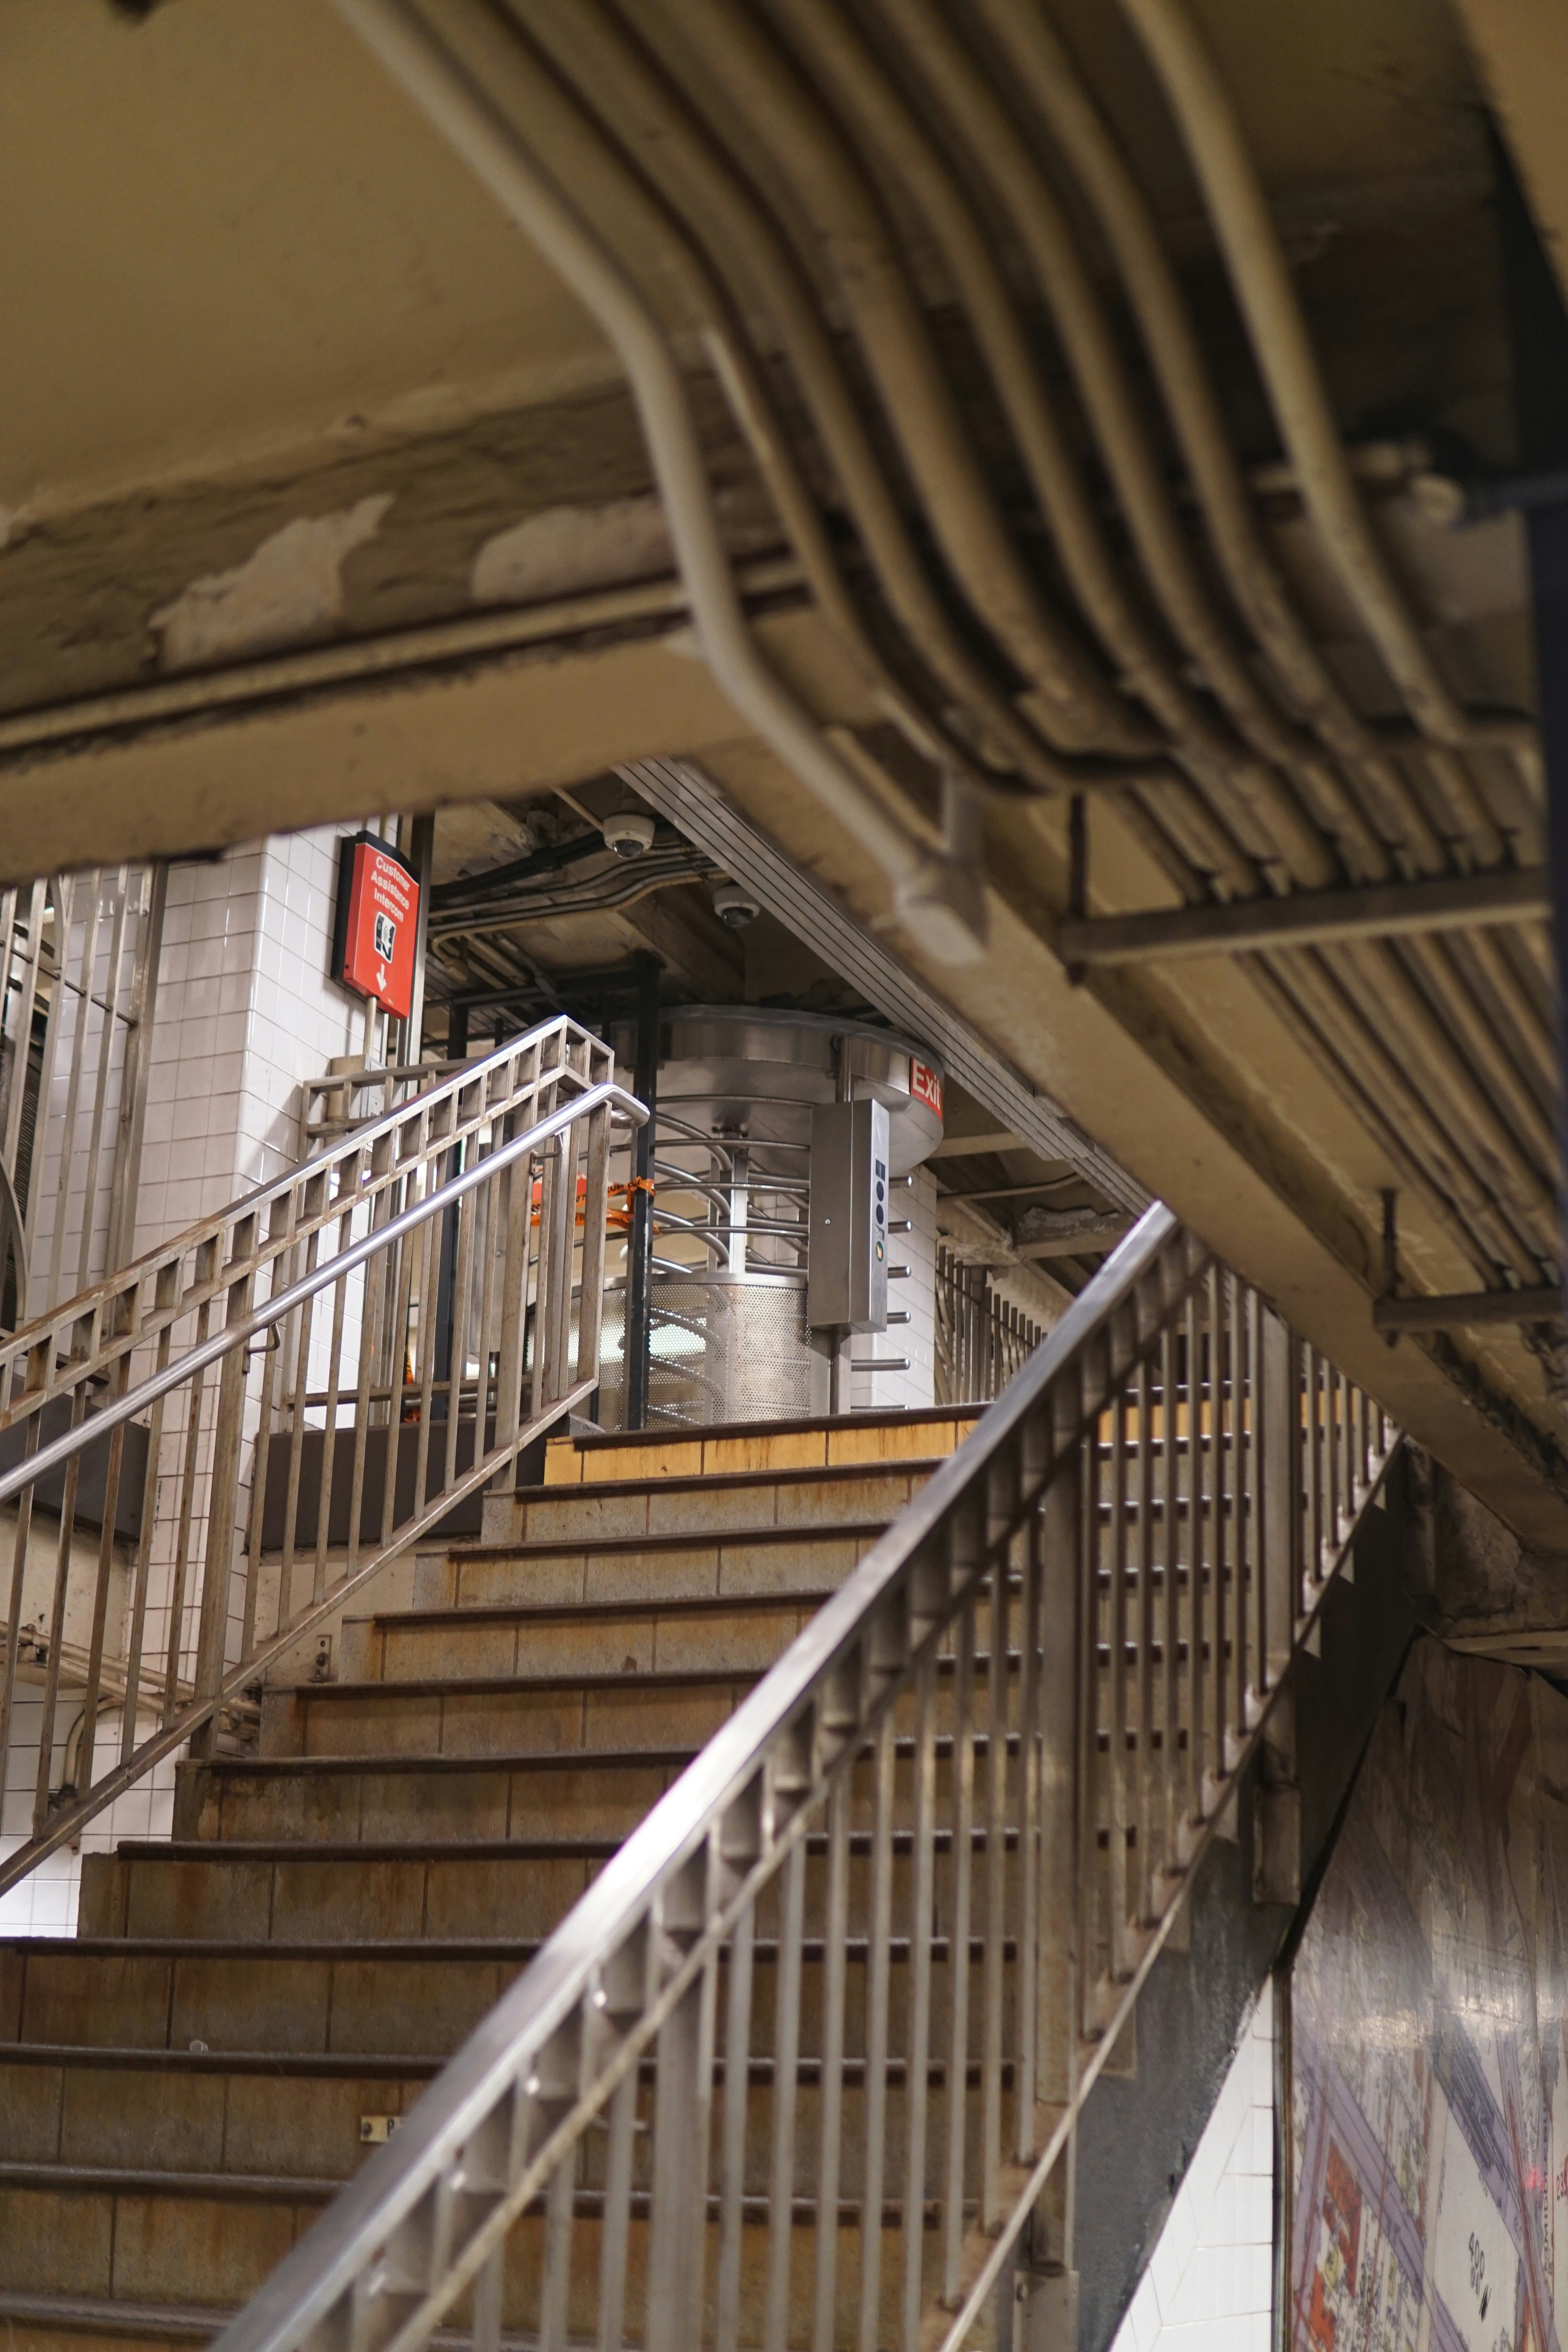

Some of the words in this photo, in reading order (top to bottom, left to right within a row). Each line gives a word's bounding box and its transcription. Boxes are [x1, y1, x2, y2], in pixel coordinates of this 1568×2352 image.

[371, 870, 410, 910] Assistance
[376, 856, 410, 892] Customer
[374, 887, 404, 922] Intercom
[913, 1059, 940, 1110] Exit
